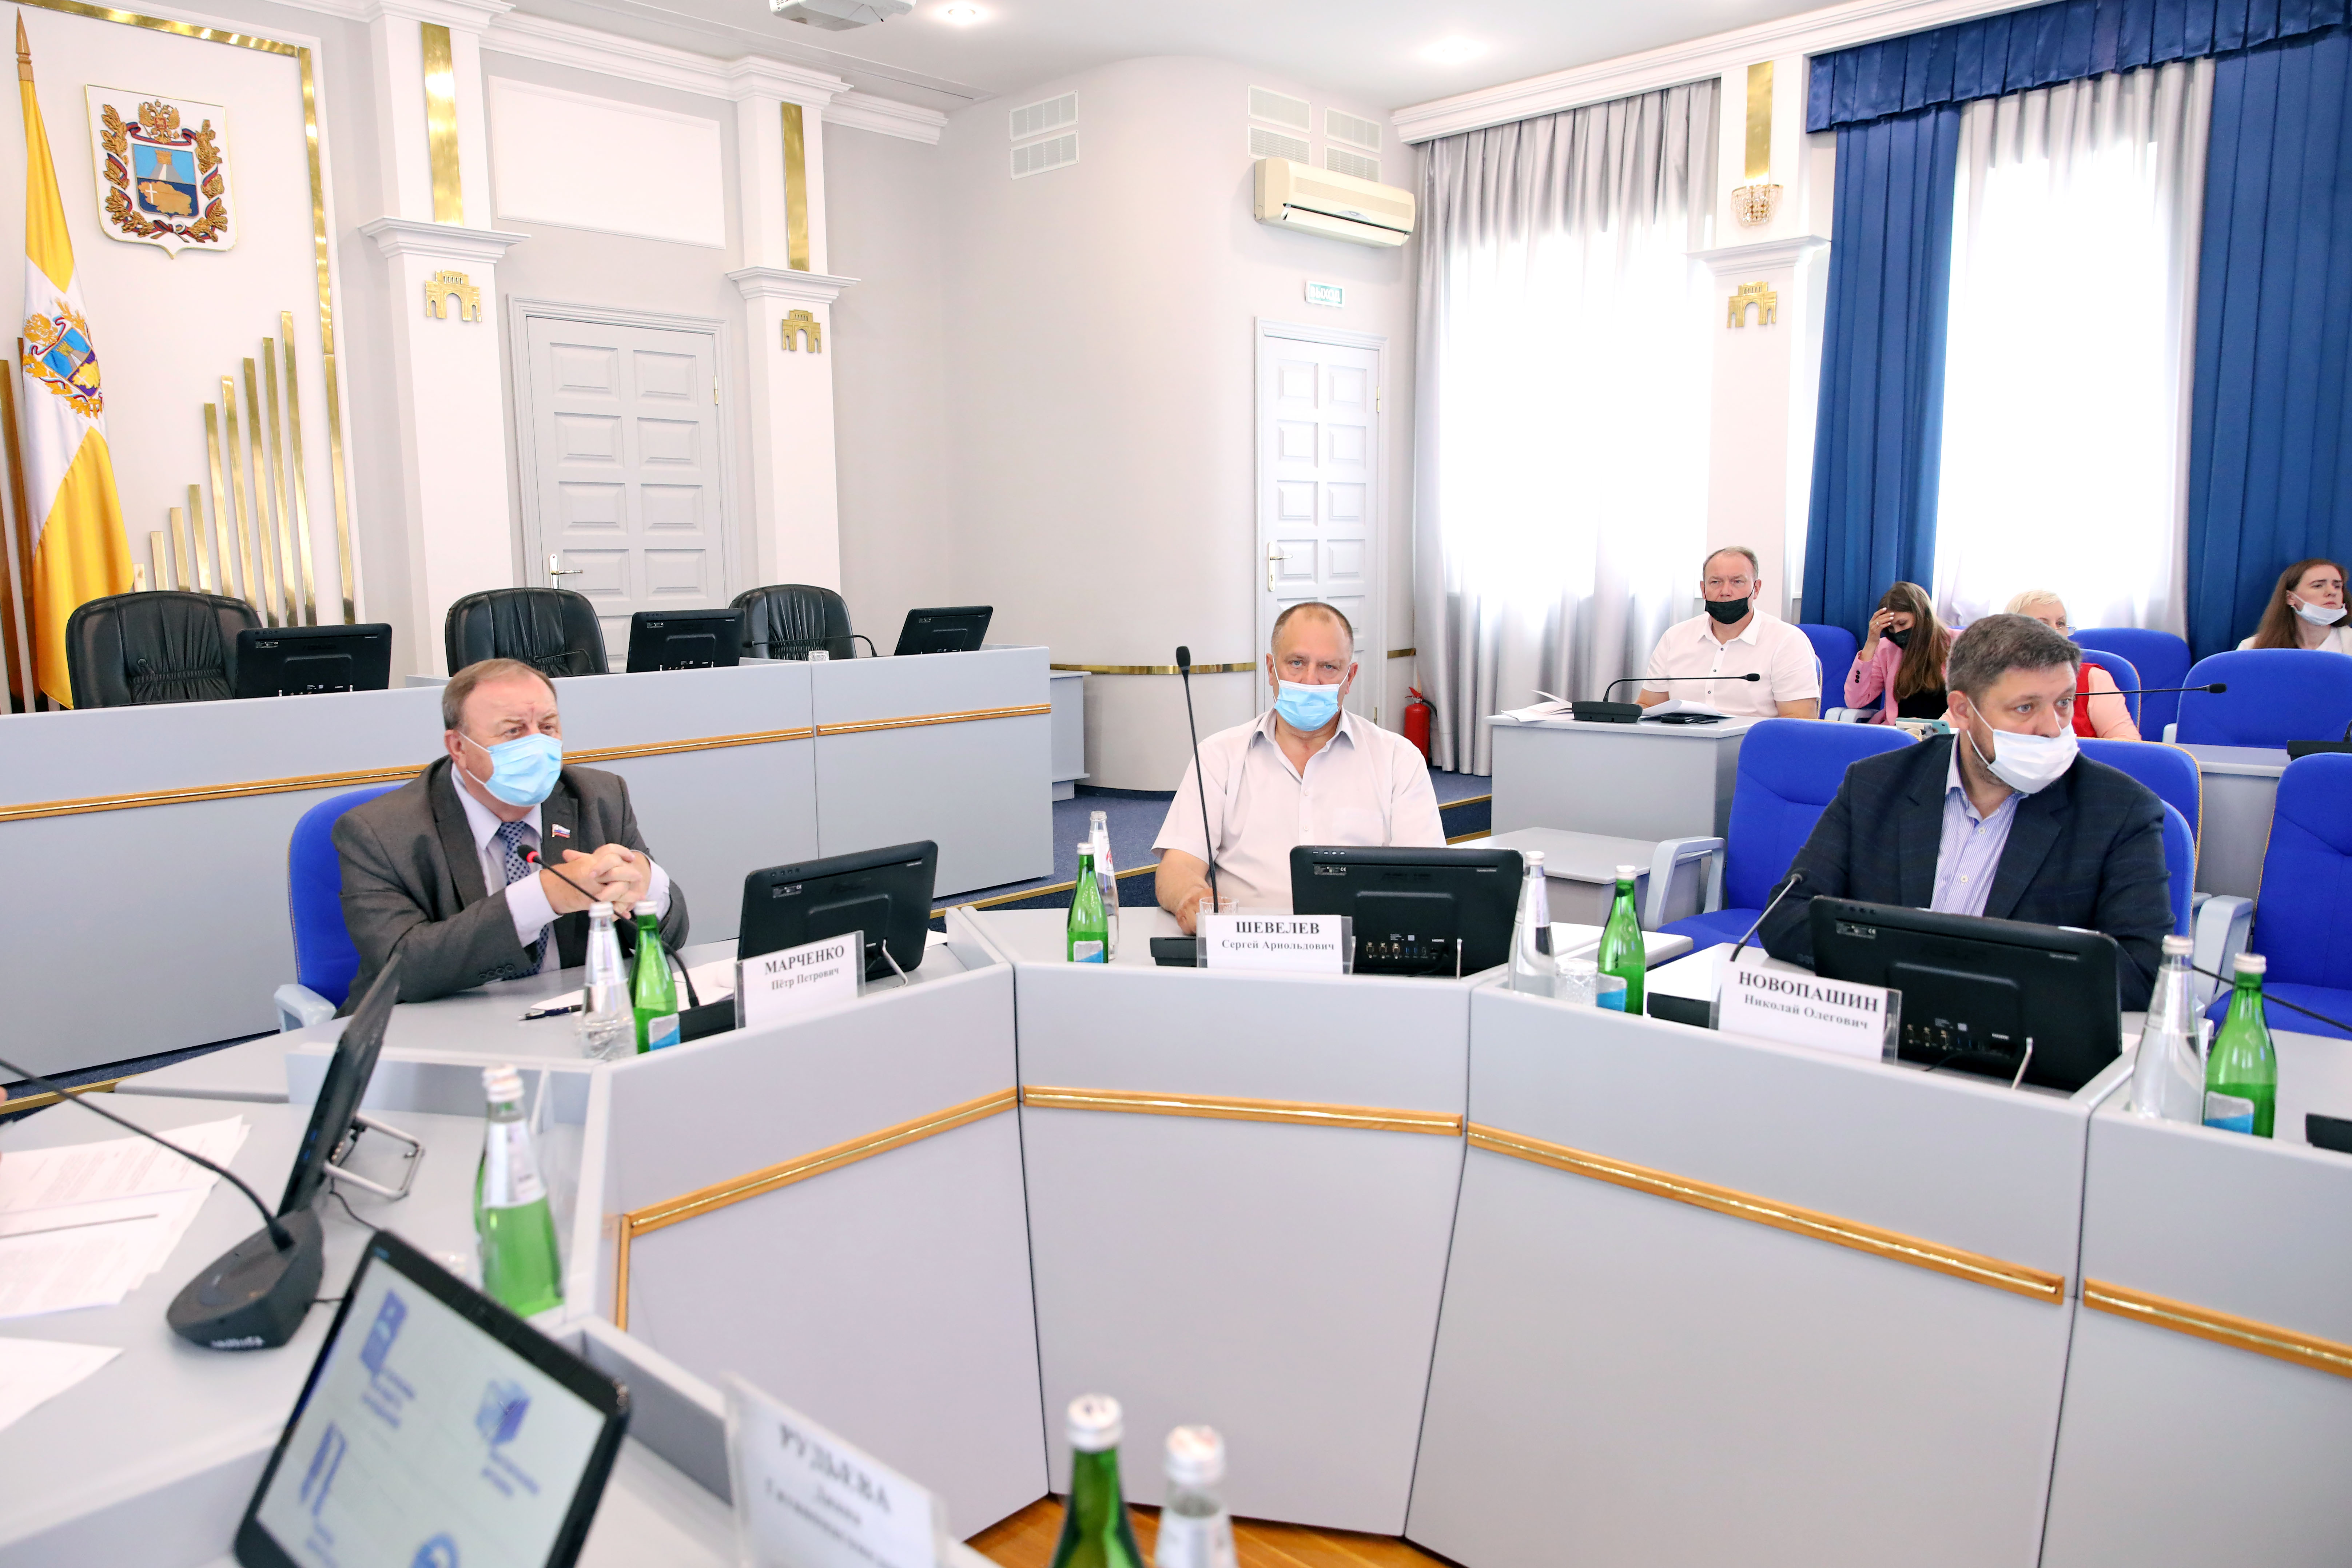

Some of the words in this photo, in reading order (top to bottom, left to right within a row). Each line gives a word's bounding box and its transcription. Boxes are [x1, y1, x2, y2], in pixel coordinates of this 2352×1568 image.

[1310, 286, 1341, 302] ВЫХОД
[1236, 921, 1320, 934] ШЕВЕЛЕВ
[1222, 939, 1258, 951] Сергей
[1263, 941, 1334, 952] Арнольдович
[765, 945, 845, 974] МАРЧЕНКО
[772, 978, 795, 991] Пётр
[797, 967, 839, 984] Петрович
[1739, 971, 1878, 1012] НОВОПАШИН
[1744, 994, 1800, 1015] Николай
[1803, 1007, 1868, 1030] Олегович
